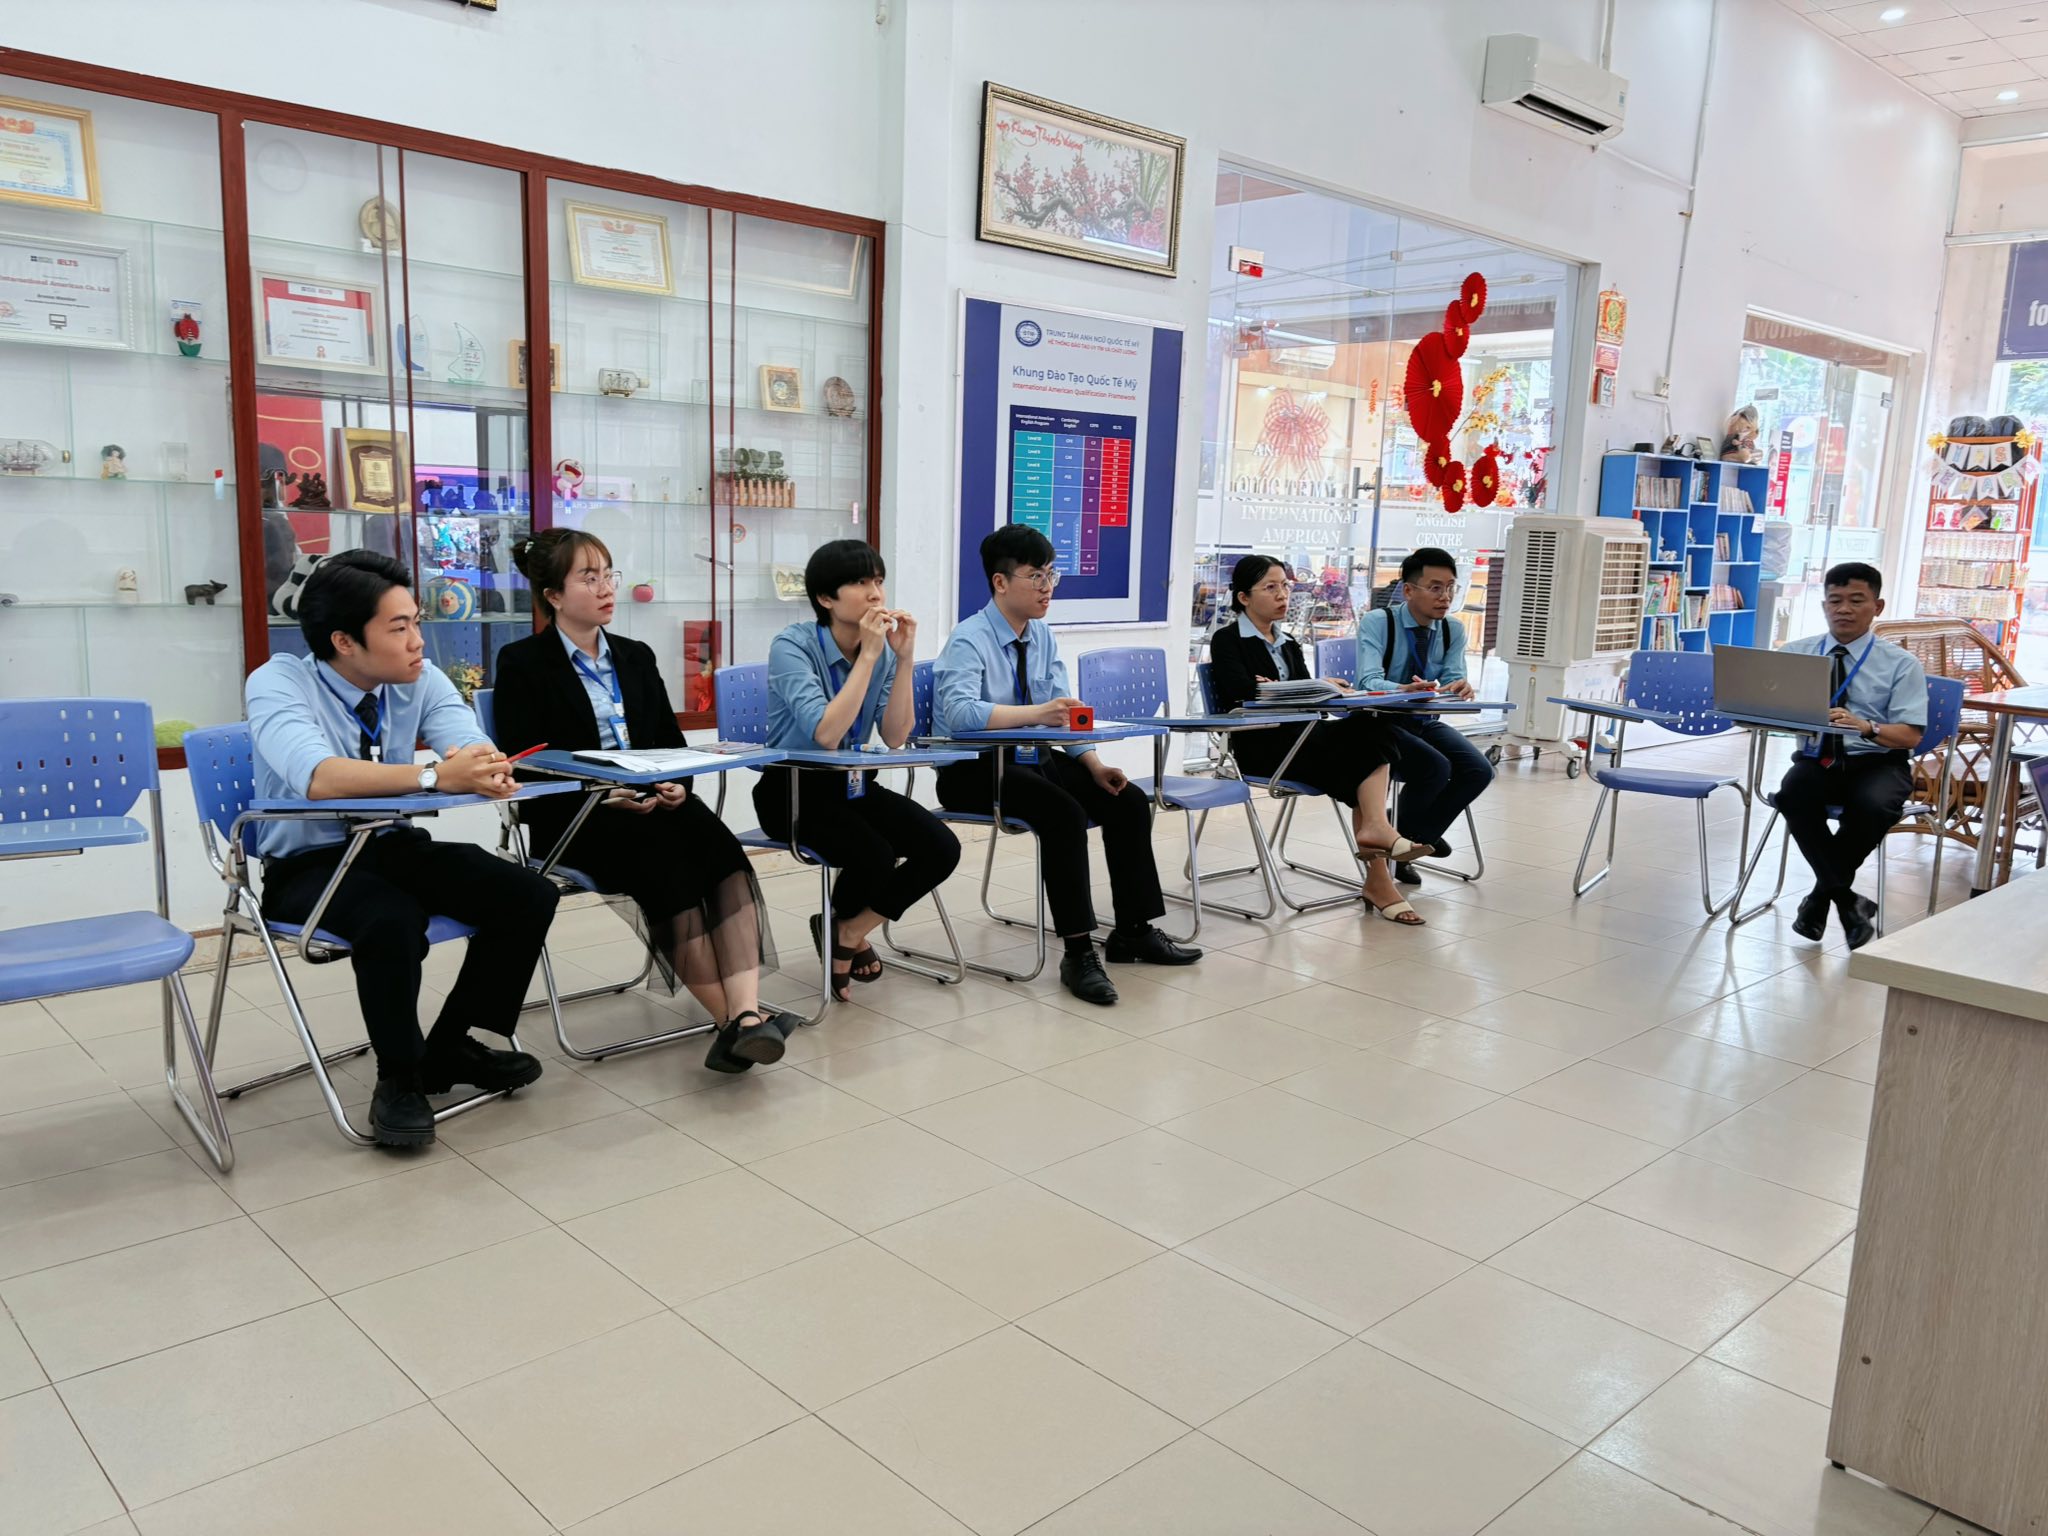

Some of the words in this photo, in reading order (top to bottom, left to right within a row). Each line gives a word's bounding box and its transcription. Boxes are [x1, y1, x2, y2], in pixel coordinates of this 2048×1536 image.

[56, 258, 79, 267] IELTS
[1046, 328, 1066, 338] TRUNG
[1067, 330, 1079, 340] TÂM
[1080, 333, 1093, 341] ANH
[1107, 336, 1123, 346] QUỐC
[1123, 338, 1131, 347] TẾ
[1012, 365, 1045, 381] Khung
[1047, 368, 1066, 381] Đào
[1068, 371, 1085, 384] Tạo
[1086, 373, 1110, 386] Quốc
[1112, 376, 1123, 388] Tế
[1124, 378, 1138, 391] Mỹ
[1012, 382, 1047, 392] International
[1048, 385, 1074, 395] American
[1074, 388, 1107, 398] Qualification
[1108, 392, 1137, 401] Framework
[1241, 503, 1360, 524] INTERNATIONAL
[1415, 514, 1466, 530] ENGLISH
[1261, 527, 1342, 545] AMERICAN
[1415, 532, 1464, 547] CENTRE
